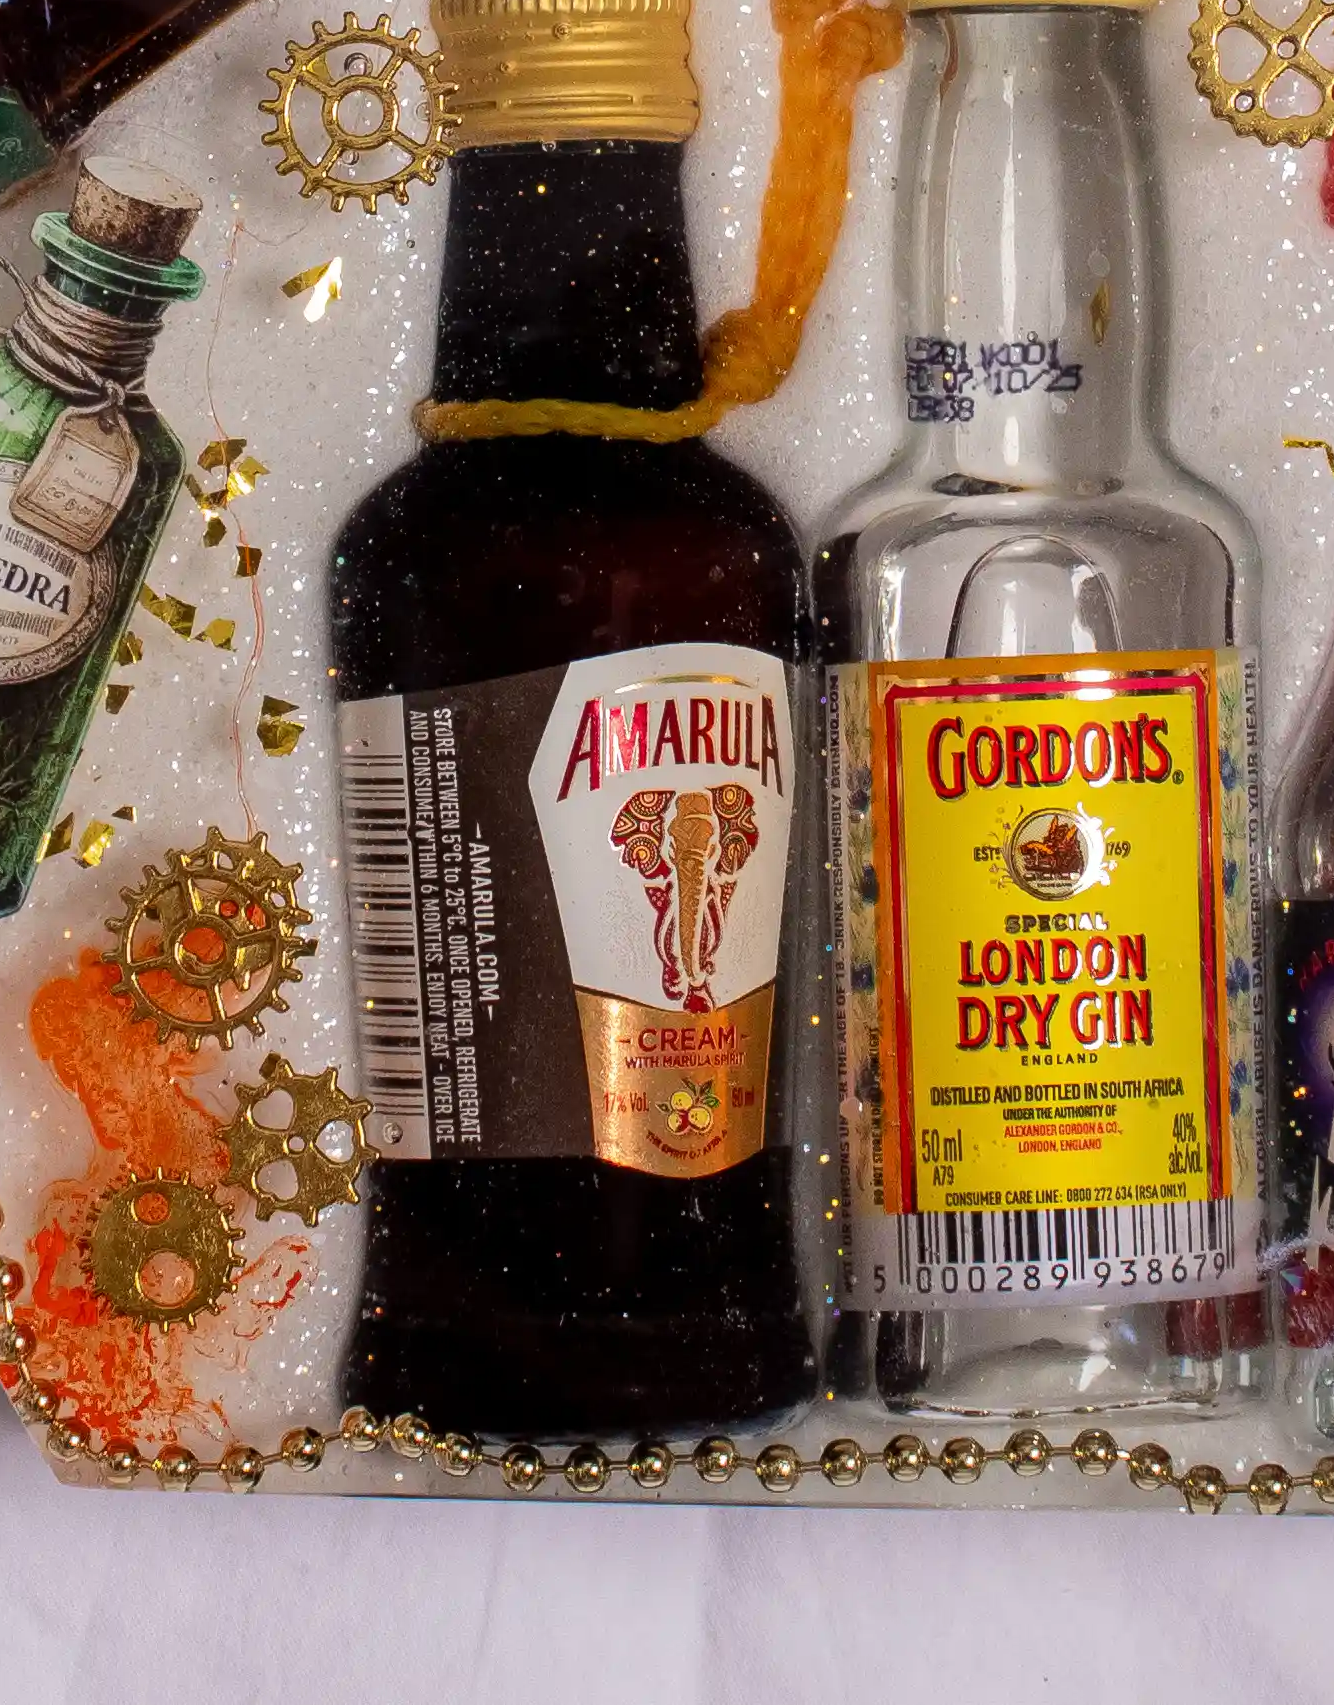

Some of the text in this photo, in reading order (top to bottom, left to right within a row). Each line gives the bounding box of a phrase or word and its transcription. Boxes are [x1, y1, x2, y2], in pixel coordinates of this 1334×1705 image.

[409, 709, 429, 742] AND
[433, 707, 456, 757] STORE
[556, 694, 784, 804] AMARULA
[412, 746, 435, 821] CONSUME
[436, 760, 460, 830] BETWEEN
[1246, 752, 1259, 814] YOUR
[830, 795, 844, 897] RESPONSIBLY
[1247, 817, 1260, 848] TO
[420, 884, 439, 895] 6
[444, 867, 462, 884] to
[469, 842, 501, 1003] AMARULA.COM
[1005, 912, 1109, 934] SPECIAL
[1248, 852, 1263, 989] DANGEROUS
[447, 935, 470, 975] ONCE
[957, 933, 1149, 987] LONDON
[426, 972, 447, 1020] ENJOY
[835, 985, 847, 1007] OF
[1252, 992, 1264, 1016] IS
[835, 1011, 847, 1044] AGE
[955, 988, 1155, 1051] DRY GIN
[429, 1022, 451, 1059] NEAT
[638, 1024, 738, 1053] CREAM
[625, 1052, 746, 1069] WITH MARULA SPIRIT
[836, 1045, 849, 1077] THE
[1020, 1053, 1099, 1066] ENGLAND
[1253, 1020, 1265, 1098] ABUSE
[432, 1077, 453, 1115] OVER
[455, 1046, 482, 1144] REFRIGERATE
[930, 1077, 1184, 1106] DISTILLED AND BOTTLED IN SOUTH AFRICA
[837, 1080, 850, 1138] UNER
[1003, 1104, 1117, 1121] UNDER THE AUTHORITY OF
[435, 1119, 456, 1144] ICE
[1004, 1124, 1057, 1138] ALEXANDER
[1058, 1122, 1096, 1136] GORDON
[1097, 1122, 1105, 1134] &
[1172, 1112, 1197, 1143] 40%
[921, 1129, 963, 1163] 50 ml
[1060, 1138, 1102, 1152] ENGLAND
[839, 1141, 852, 1218] PERSONS
[932, 1165, 955, 1186] A79
[945, 1182, 1187, 1207] CONSUMER CARE LINE: 0800 272 634 (RSA ONLY)
[874, 1252, 1226, 1294] 5 000289 938679
